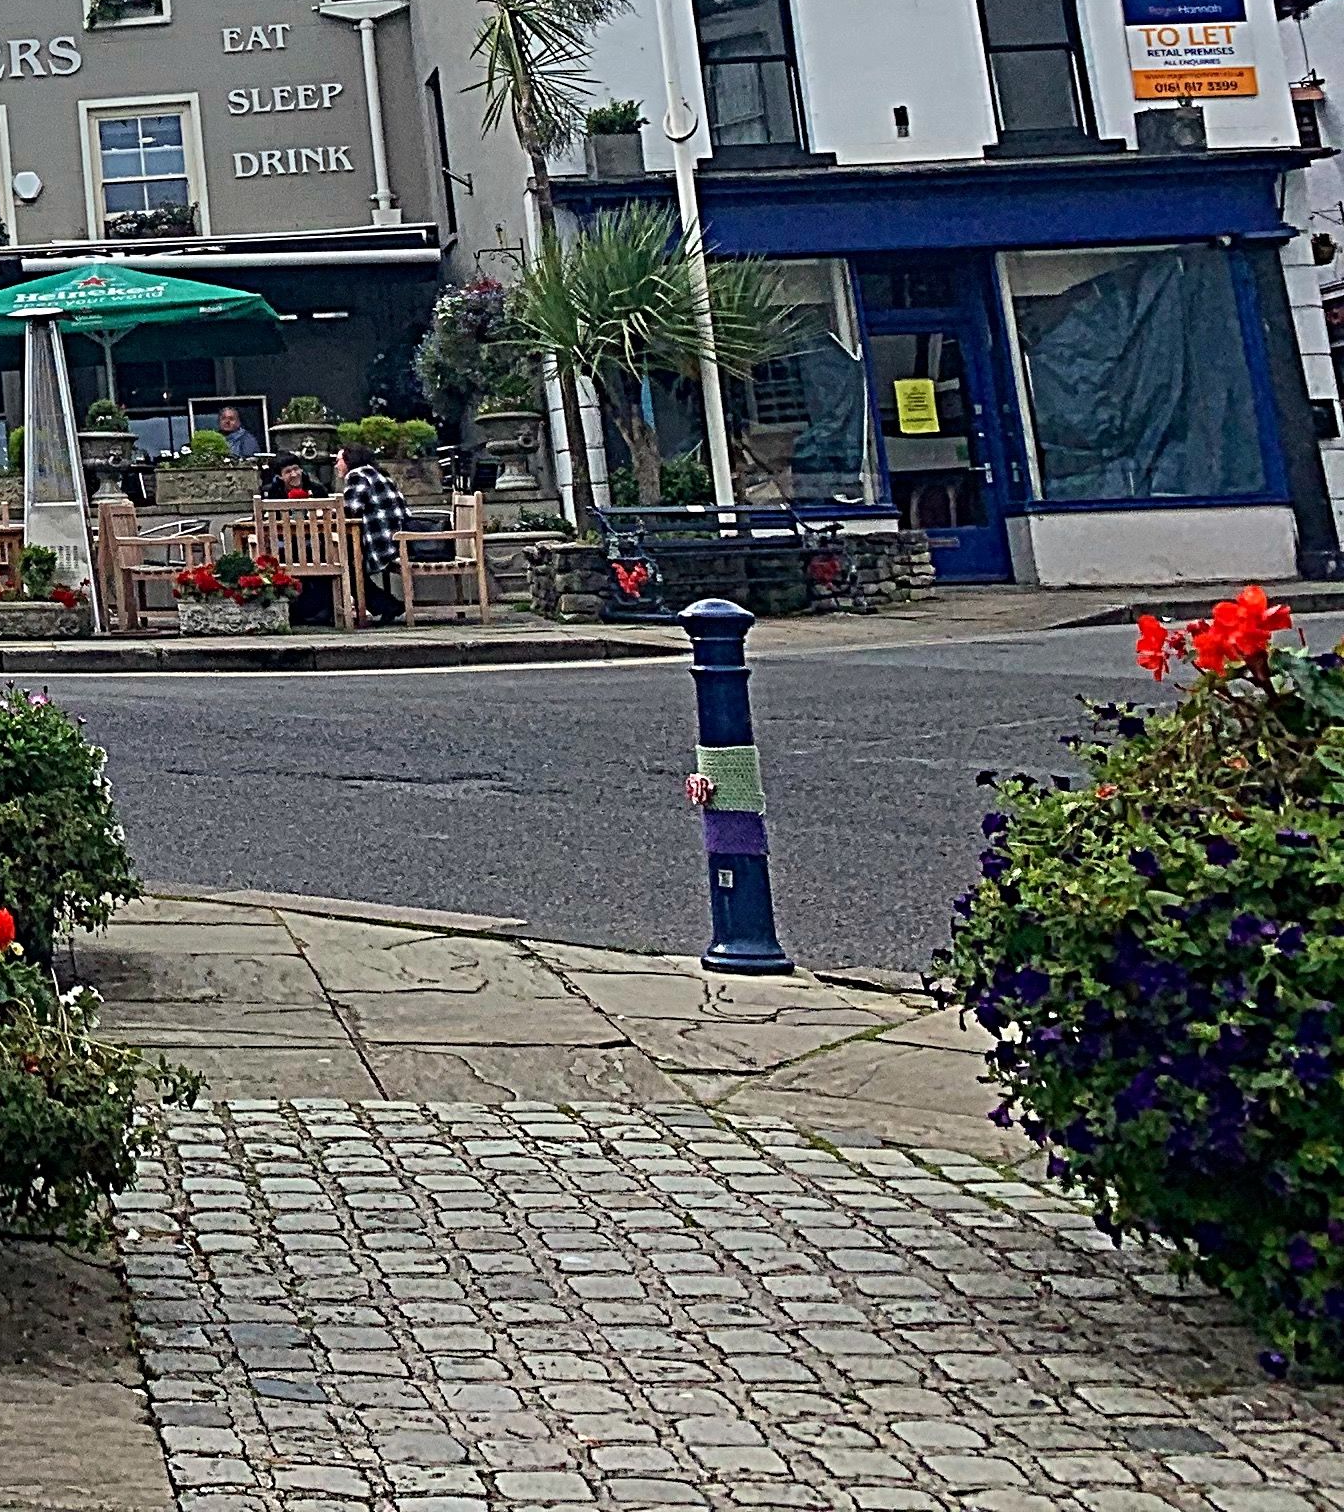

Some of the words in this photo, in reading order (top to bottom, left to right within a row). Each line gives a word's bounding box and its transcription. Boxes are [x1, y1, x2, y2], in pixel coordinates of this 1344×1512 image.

[221, 23, 290, 53] EAT
[1138, 27, 1180, 47] TO
[1188, 25, 1237, 46] LET
[1147, 48, 1182, 57] RETAIL
[1184, 47, 1235, 56] PREMISES
[1155, 82, 1180, 93] 0161
[1207, 81, 1238, 92] 3399
[227, 83, 343, 115] SLEEP
[232, 145, 355, 178] DRINK
[15, 285, 166, 303] Heineken
